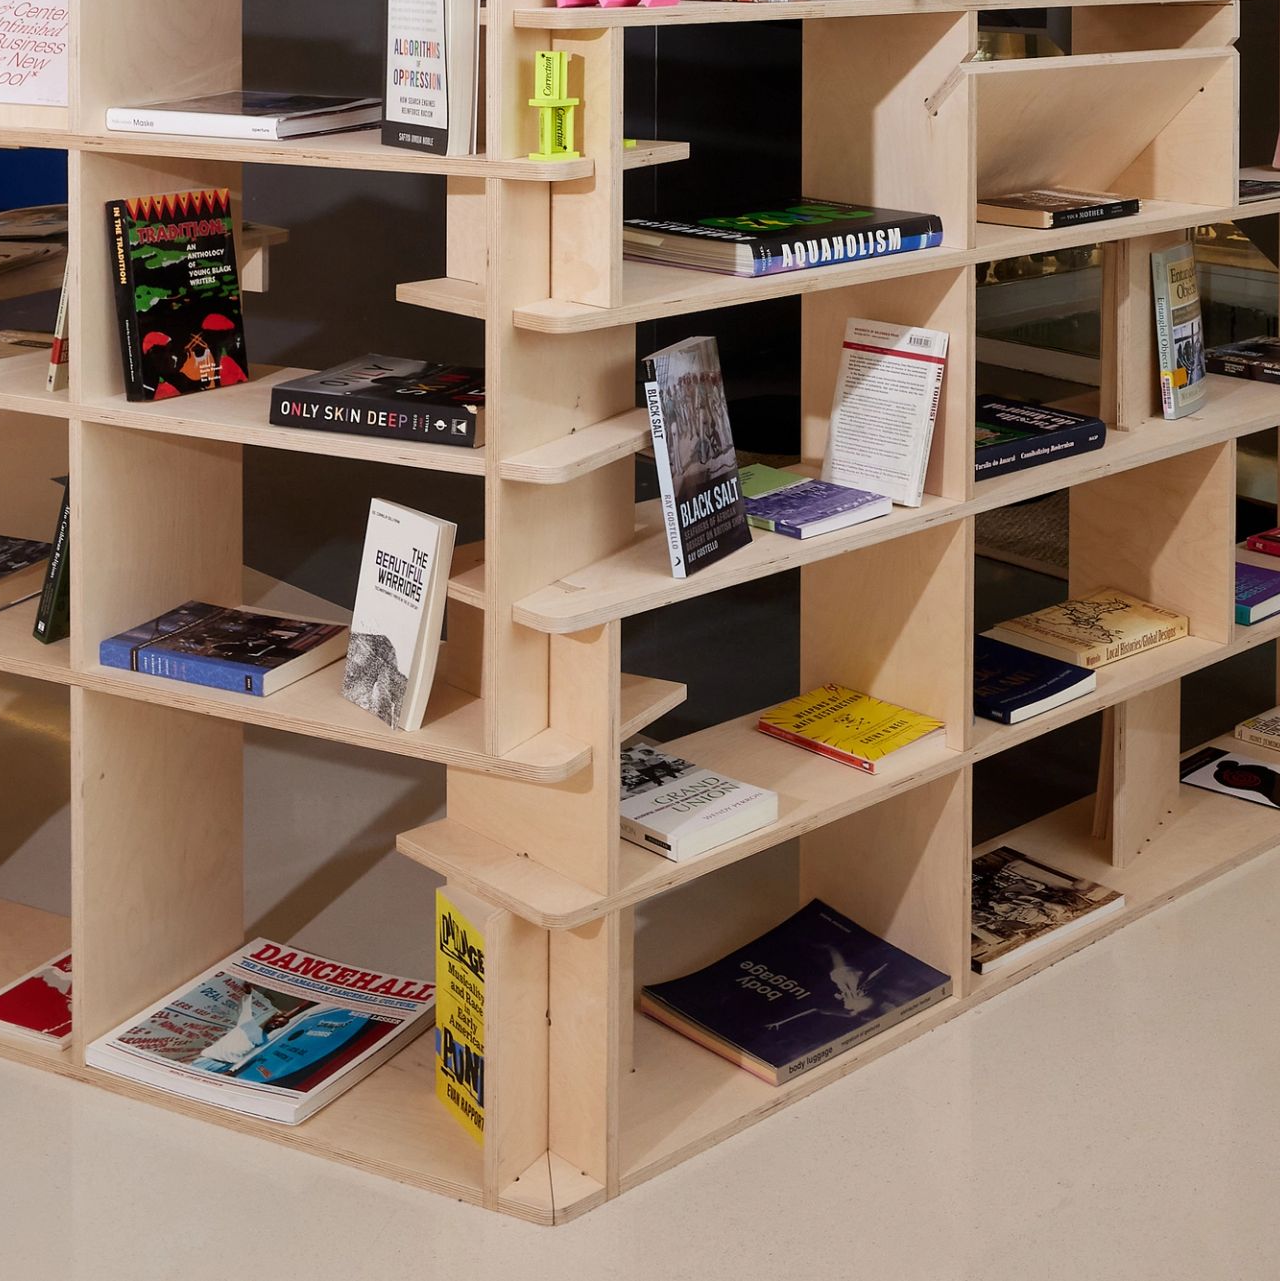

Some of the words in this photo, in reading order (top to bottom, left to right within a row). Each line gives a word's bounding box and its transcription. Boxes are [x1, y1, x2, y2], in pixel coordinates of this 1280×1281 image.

[7, 52, 51, 70] New
[394, 38, 441, 59] ALGORITHMS
[393, 69, 442, 90] OPPRESSION
[543, 56, 552, 96] Correction
[133, 119, 154, 127] Maske
[557, 108, 565, 147] Correction
[113, 207, 119, 217] IN
[116, 236, 127, 285] TRADITION
[186, 243, 196, 251] AN
[187, 249, 225, 260] ANTHOLOGY
[782, 227, 901, 268] AQUAHOLISM
[188, 261, 196, 269] OF
[189, 268, 211, 277] YOUNG
[211, 265, 232, 275] BLACK
[189, 277, 216, 286] WRITERS
[1157, 297, 1166, 337] Entangled
[1161, 338, 1169, 369] Objects
[281, 401, 319, 418] ONLY
[324, 406, 361, 424] SKIN
[367, 410, 408, 429] DEEP
[647, 388, 659, 417] BLACK
[930, 386, 940, 421] TOURIST
[651, 416, 664, 439] SALT
[664, 494, 672, 510] RAY
[680, 491, 713, 528] BLACK
[713, 476, 740, 510] SALT
[665, 511, 679, 550] COSTELLO
[412, 547, 428, 569] THE
[687, 549, 698, 564] RAY
[697, 539, 719, 560] COSTELLO
[376, 550, 423, 585] BEAUTIFUL
[378, 568, 422, 602] WARRIORS
[1106, 643, 1120, 661] Local
[1120, 631, 1158, 656] Histories/Global
[1158, 626, 1177, 642] Designs
[794, 701, 826, 718] WEAPONS
[828, 696, 840, 704] OF
[814, 694, 863, 720] DESTRUCTION
[654, 776, 720, 804] GRAND
[672, 782, 740, 812] UNION
[442, 912, 485, 974] DAMAGE
[240, 960, 256, 971] THE
[257, 964, 274, 977] RISE
[275, 969, 287, 978] OF
[288, 971, 328, 992] JAMAICAN
[329, 987, 373, 1003] DANCEHALL
[374, 997, 417, 1010] CULTURE
[250, 944, 435, 1001] DANCEHALL
[448, 961, 485, 1004] Musicality
[740, 961, 811, 1000] luggage
[450, 980, 464, 1001] and
[465, 993, 483, 1017] Race
[736, 976, 782, 1001] body
[370, 1014, 402, 1025] LESSER
[457, 1006, 477, 1035] Early
[464, 1003, 470, 1015] in
[788, 1058, 805, 1073] body
[807, 1047, 833, 1064] luggage
[447, 1084, 459, 1111] EVAN
[460, 1097, 484, 1132] RAPPORT
